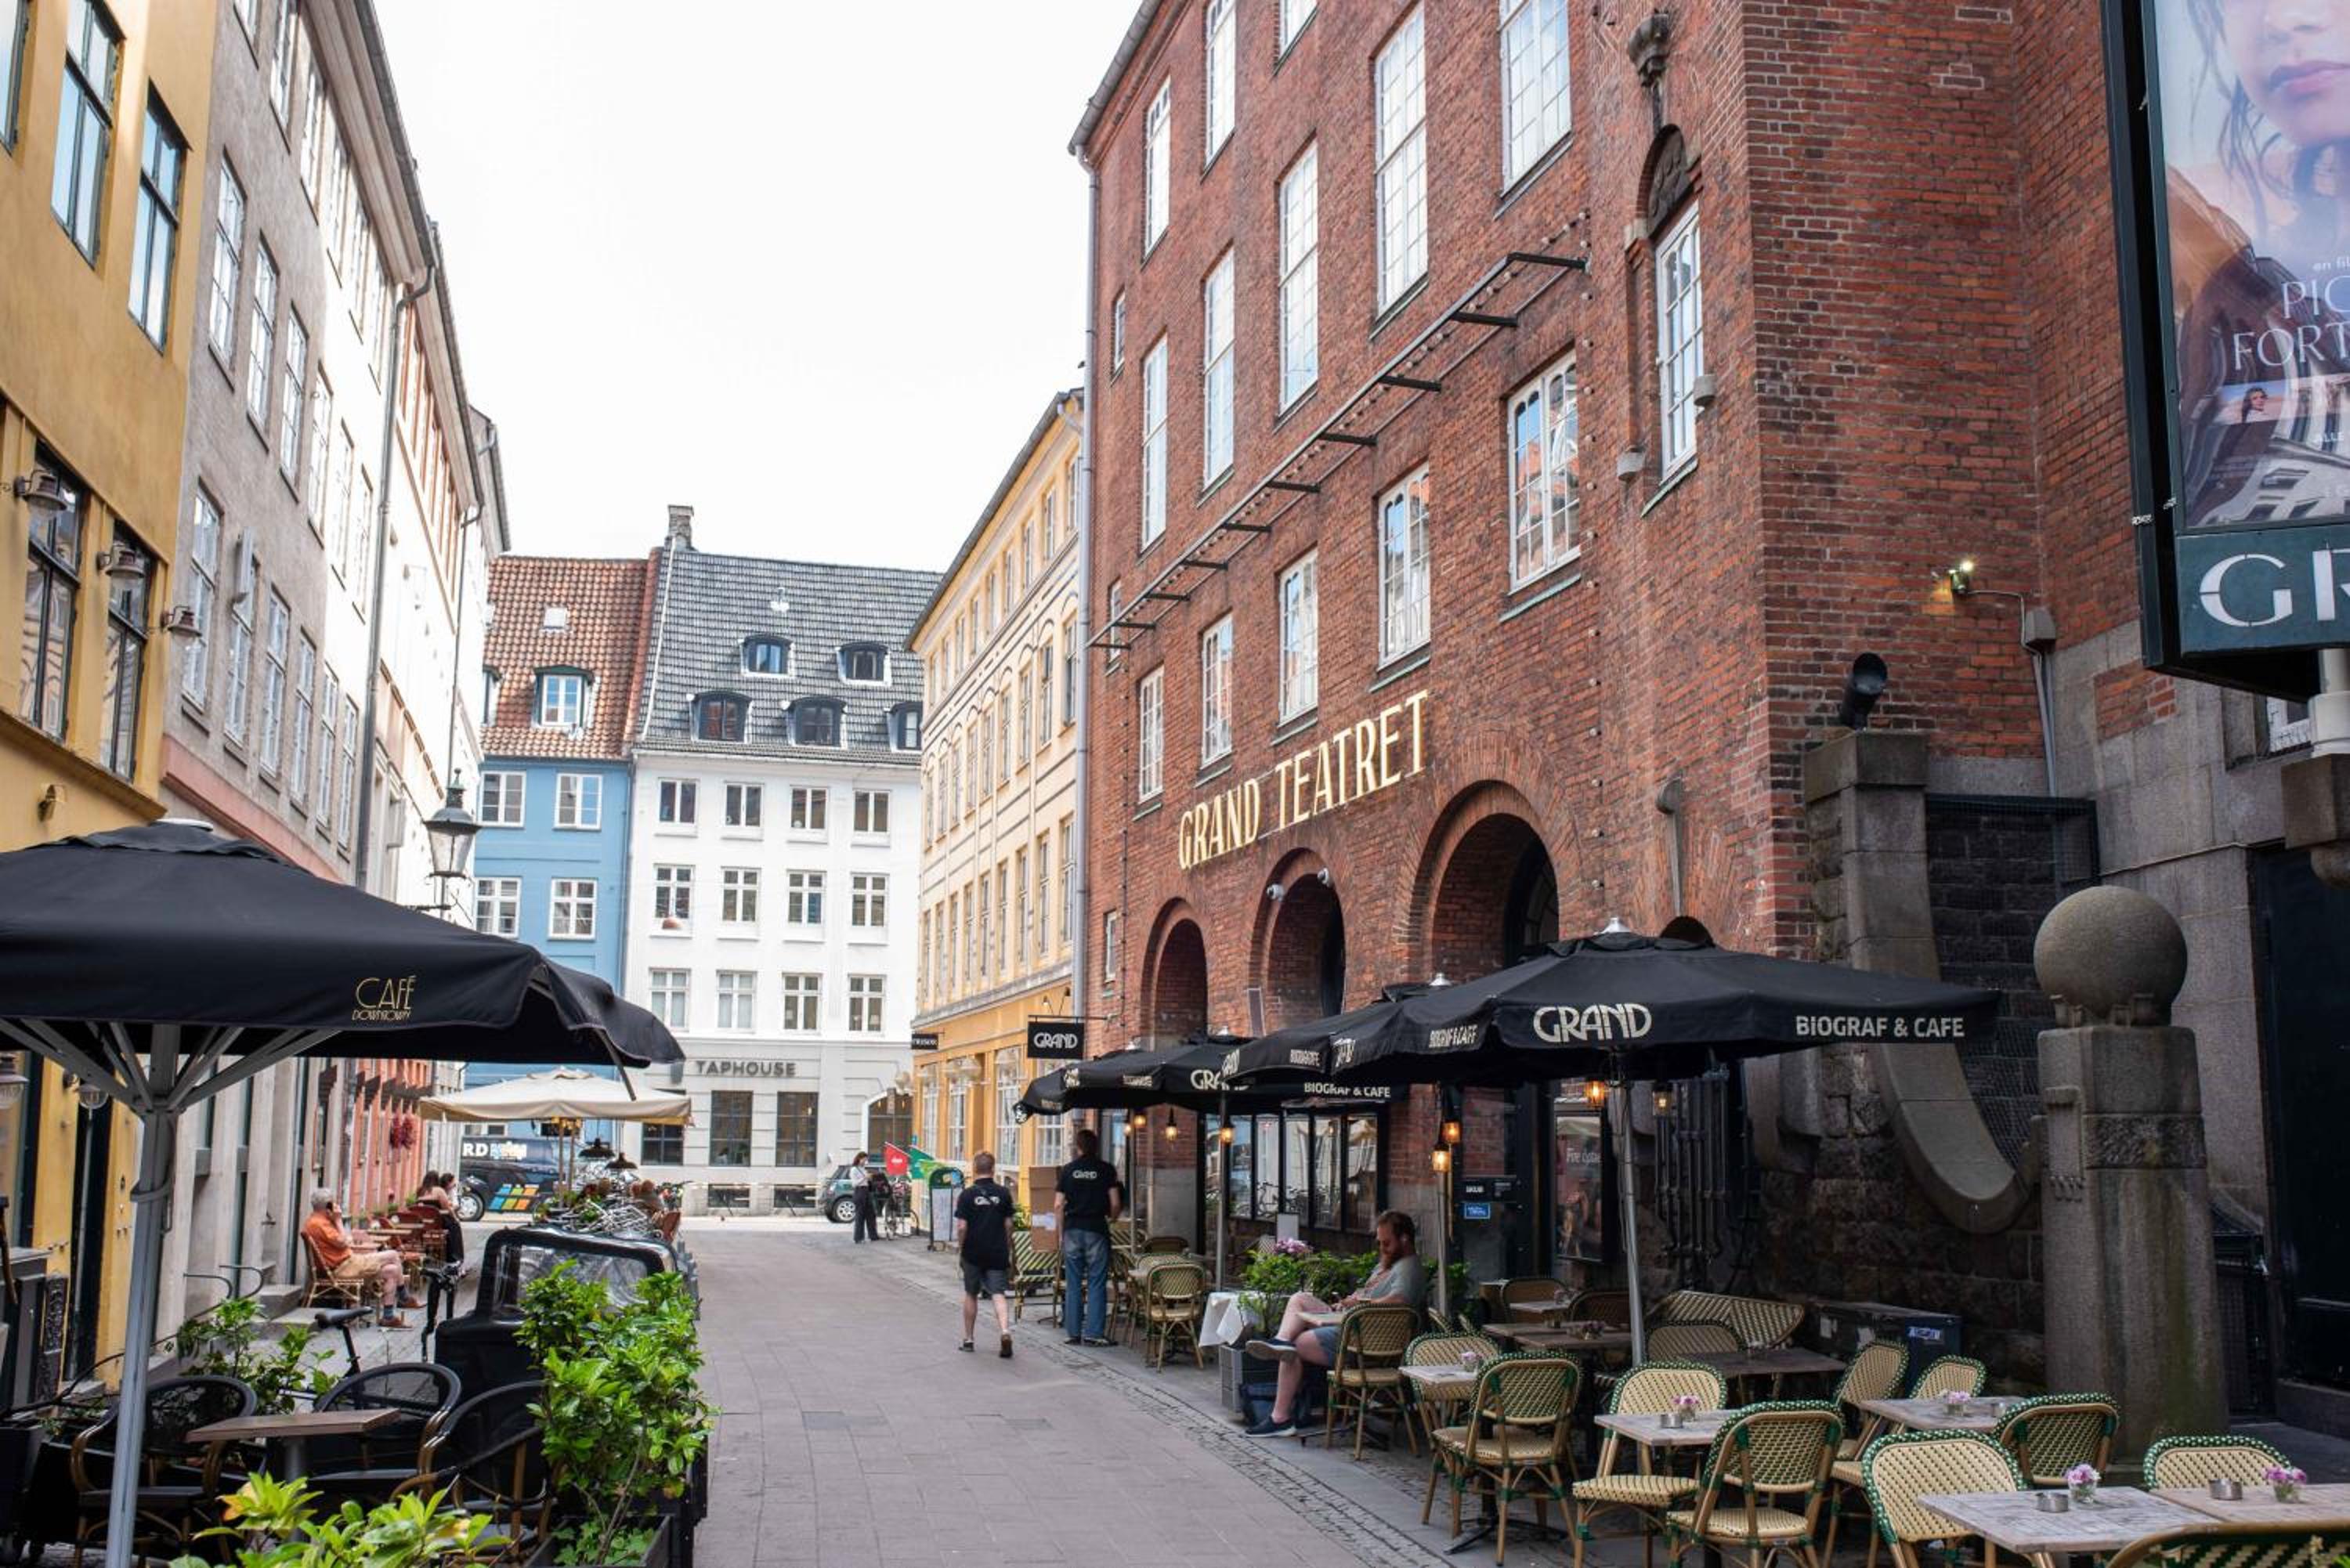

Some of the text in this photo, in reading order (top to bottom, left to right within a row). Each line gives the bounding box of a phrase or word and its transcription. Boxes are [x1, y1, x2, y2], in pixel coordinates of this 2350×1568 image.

[1178, 689, 1429, 869] GRAND TEATRET
[355, 974, 417, 1010] CAFÉ
[1533, 1003, 1652, 1042] GRAND
[1894, 1017, 1909, 1038] &
[1914, 1017, 1965, 1038] CAFE
[1033, 1031, 1079, 1050] GRAND
[696, 1060, 797, 1077] TAPHOUSE
[1190, 1069, 1249, 1091] GRA
[1353, 1086, 1362, 1097] &
[1364, 1086, 1391, 1097] CAFE
